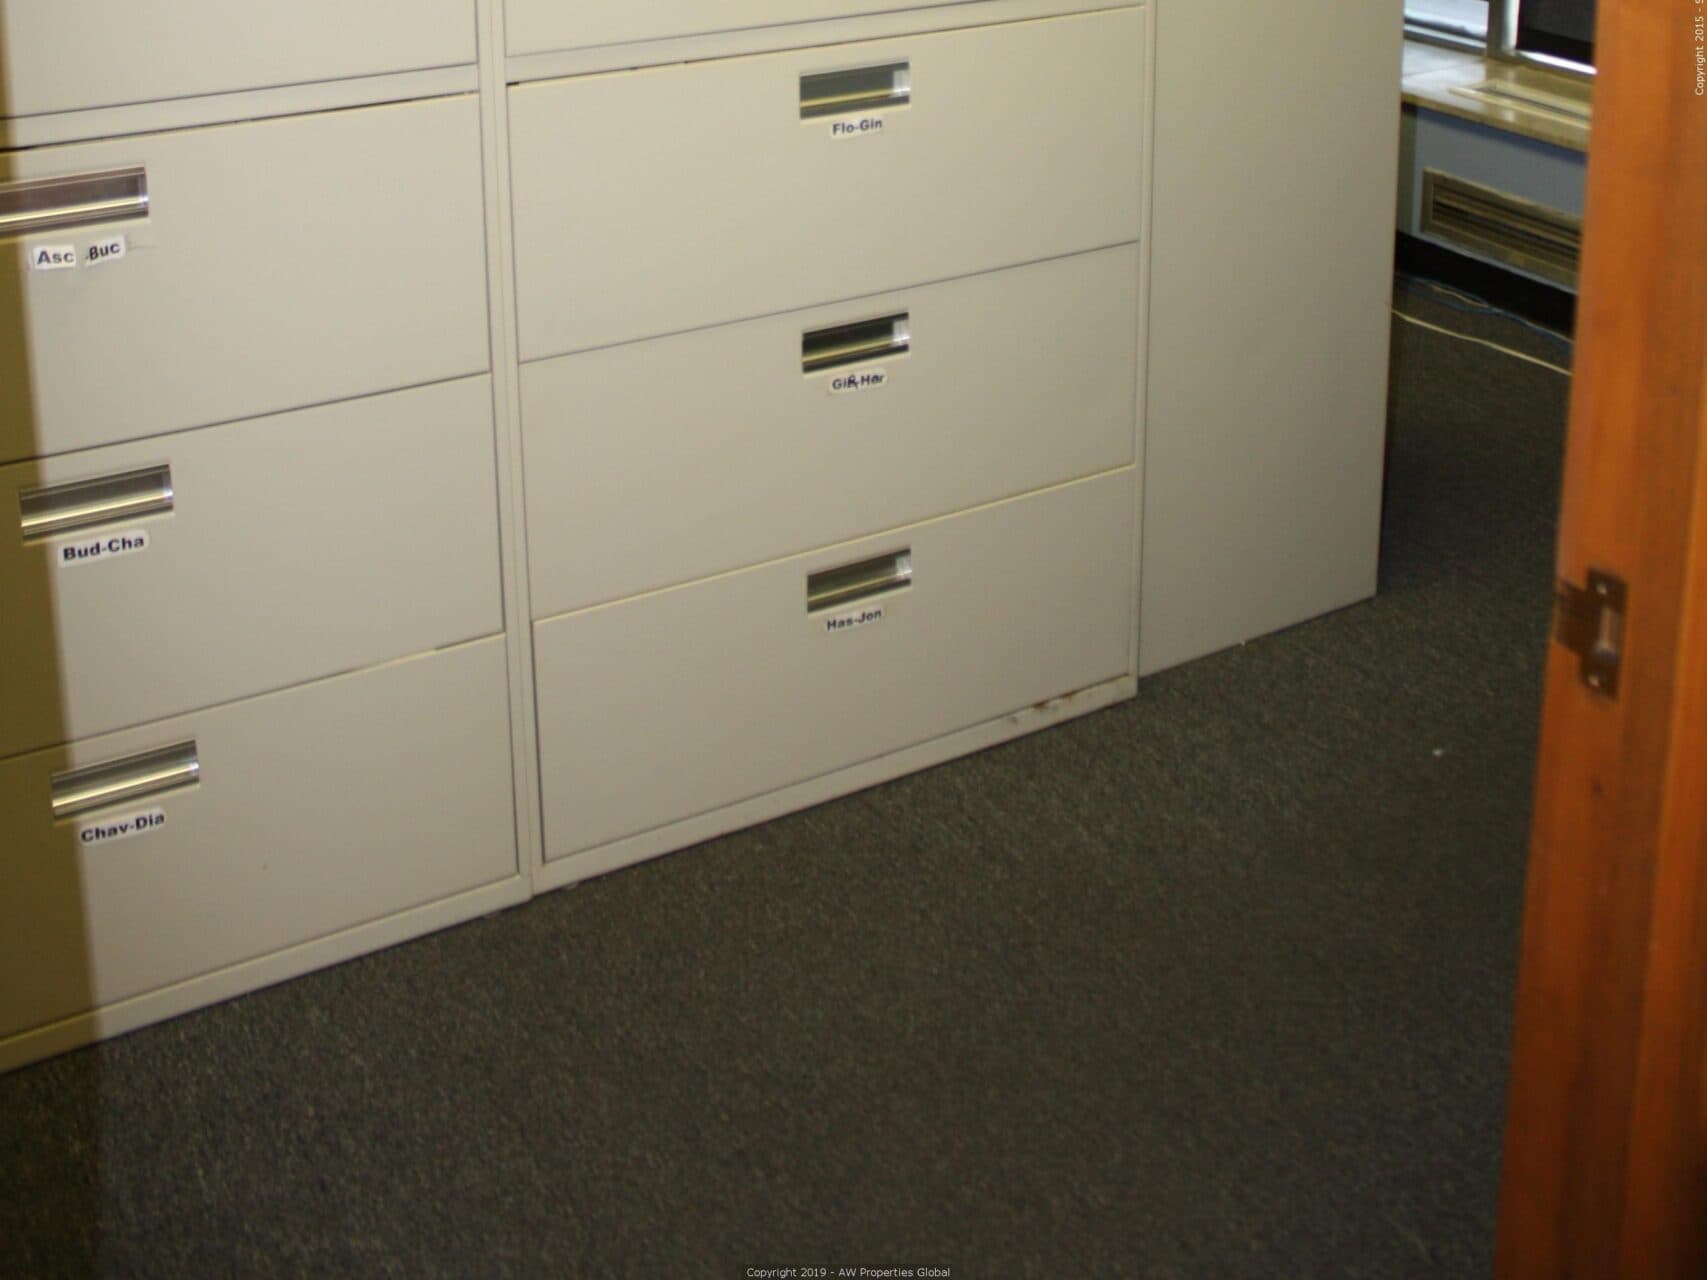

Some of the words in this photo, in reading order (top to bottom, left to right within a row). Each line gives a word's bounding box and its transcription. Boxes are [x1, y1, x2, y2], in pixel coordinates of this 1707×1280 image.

[832, 119, 883, 135] Flo-Gin
[37, 250, 75, 265] Asc
[63, 536, 145, 561] Bud-Cha
[826, 609, 882, 631] Has-Jon
[81, 813, 166, 842] Chav-Dia
